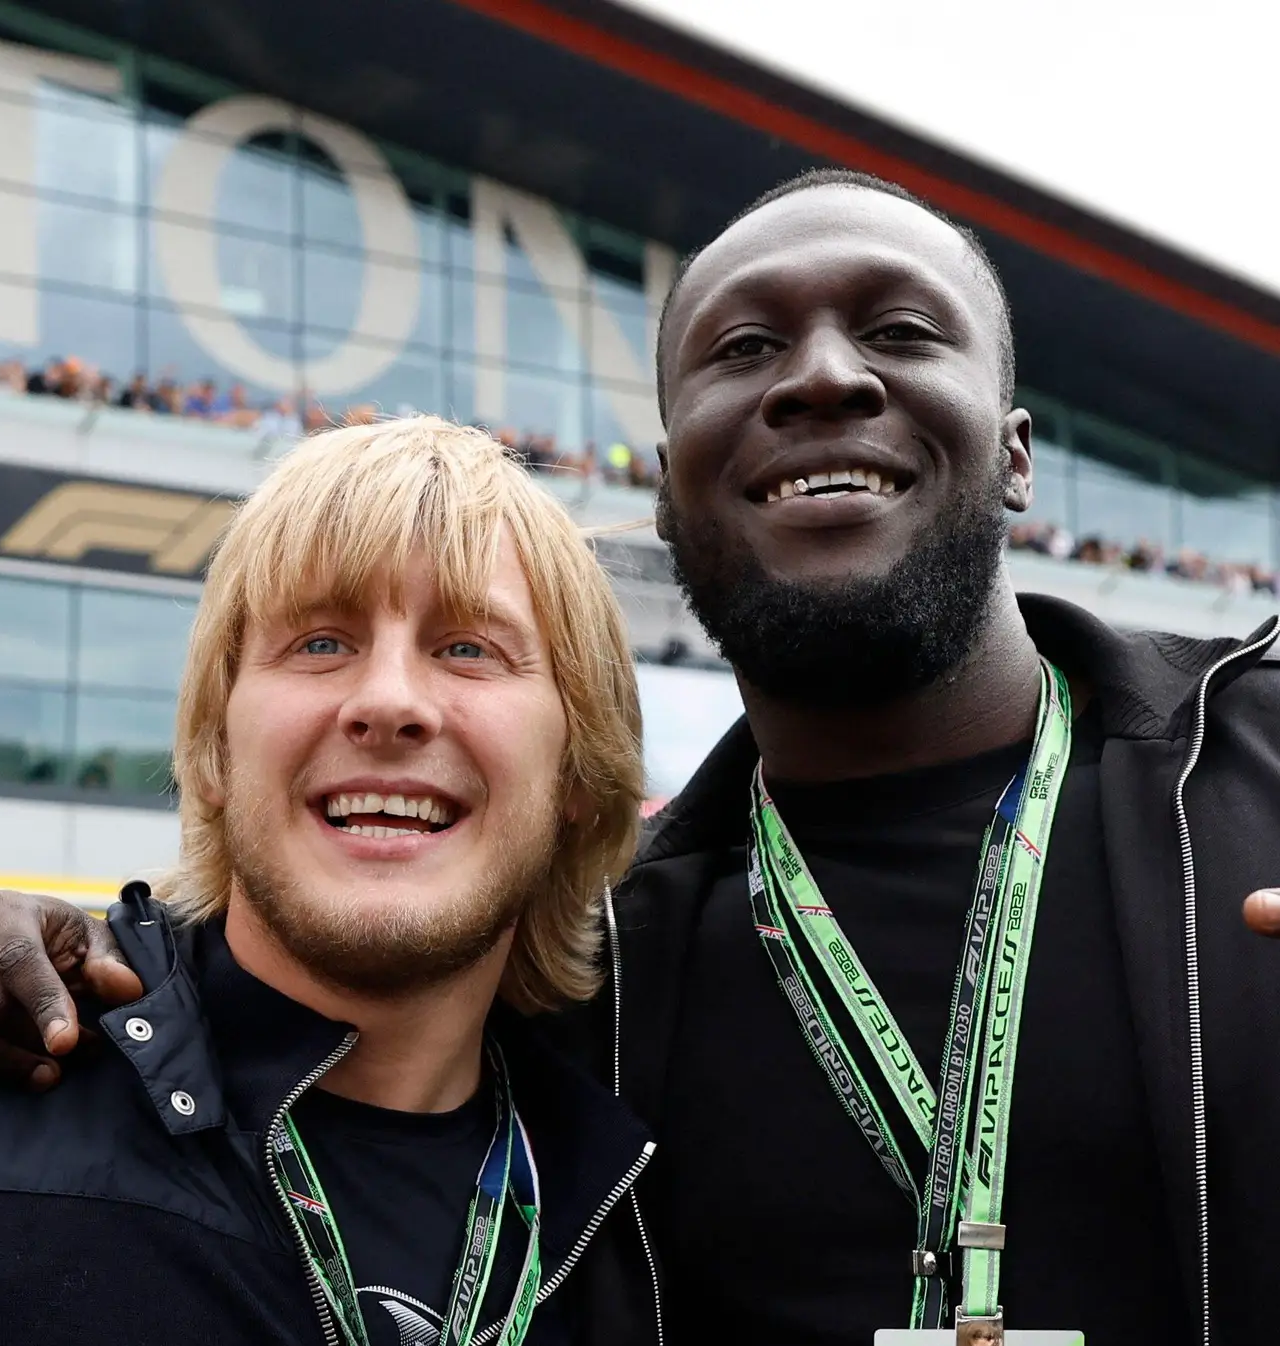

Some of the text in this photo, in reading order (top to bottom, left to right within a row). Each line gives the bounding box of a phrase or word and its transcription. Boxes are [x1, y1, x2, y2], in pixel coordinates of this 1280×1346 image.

[981, 844, 1002, 891] 2022
[971, 893, 992, 943] VIP
[1007, 882, 1027, 932] 2022
[784, 973, 813, 1023] 2022
[828, 938, 925, 1095] ACCESS 2022
[988, 933, 1018, 1067] ACCESS
[809, 1018, 854, 1096] GRID
[848, 1096, 885, 1150] VIP
[933, 1003, 971, 1208] NET ZERO CARBON BY 2030
[980, 1075, 1003, 1134] VIP
[458, 1257, 478, 1304] VIP
[471, 1215, 489, 1257] 2022
